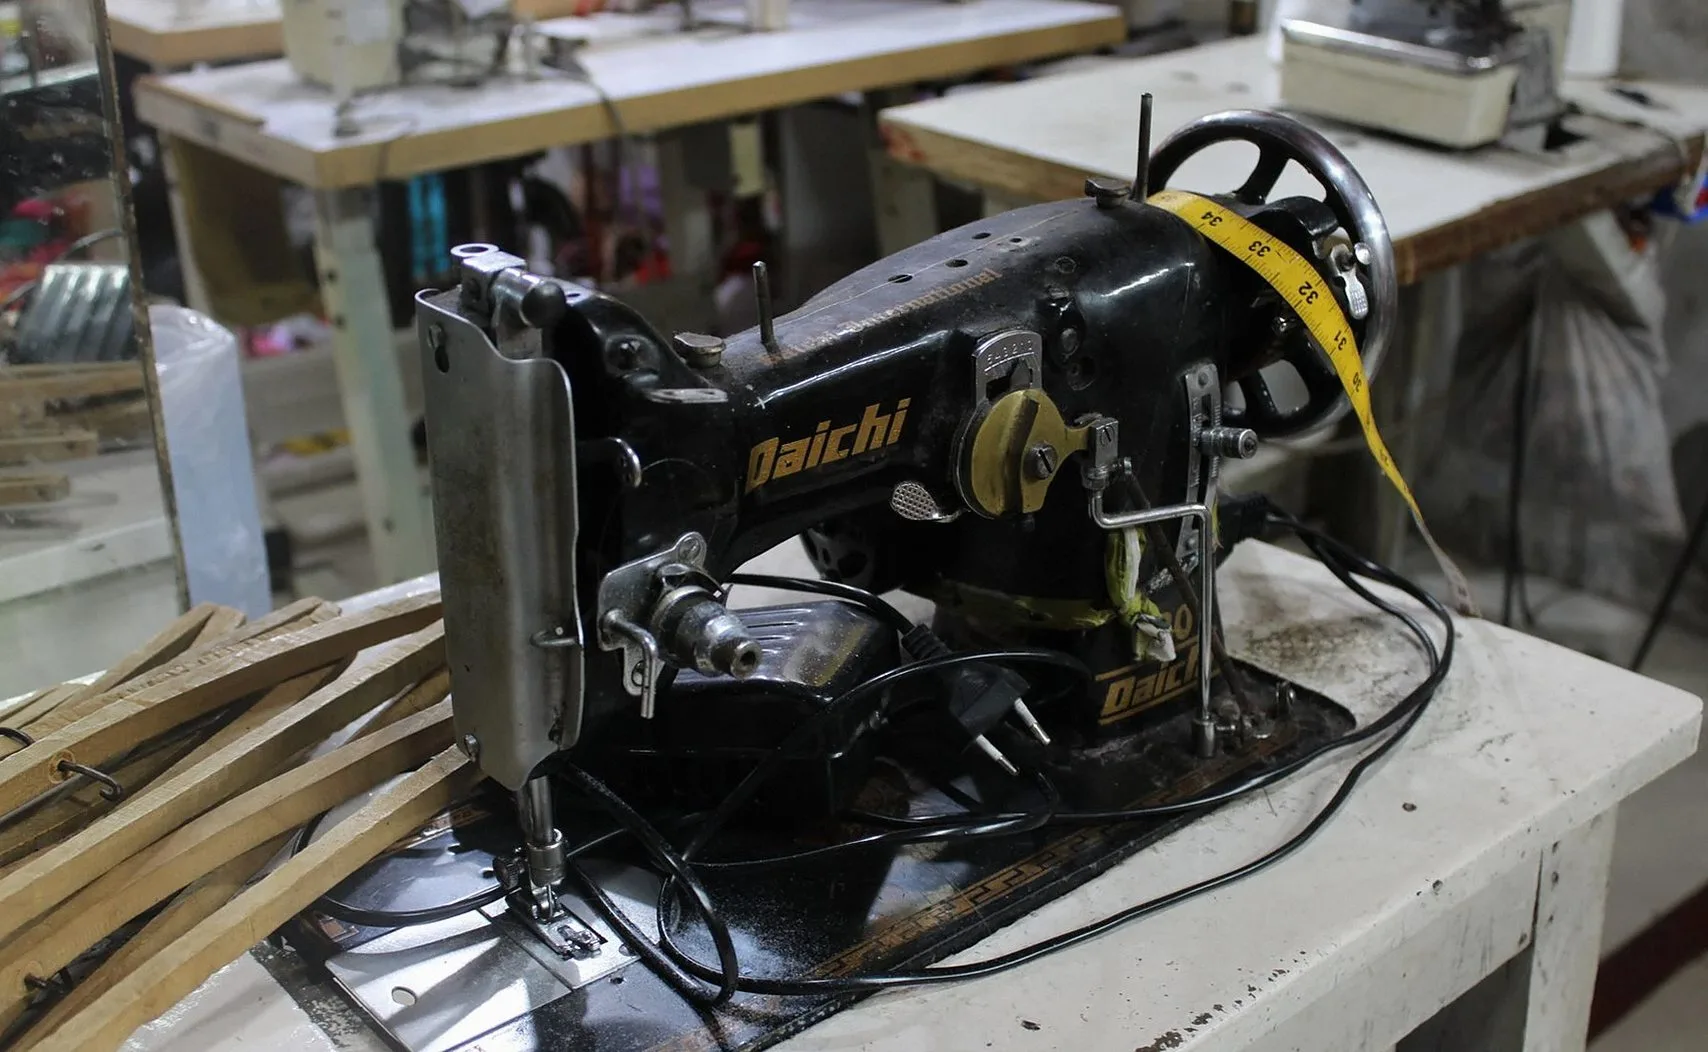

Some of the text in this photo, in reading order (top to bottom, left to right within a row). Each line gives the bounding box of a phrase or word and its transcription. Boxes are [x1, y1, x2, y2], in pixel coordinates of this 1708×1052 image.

[1200, 210, 1224, 228] 34
[1247, 240, 1272, 258] 33
[1298, 280, 1320, 305] 32
[1333, 330, 1348, 351] 31
[745, 397, 911, 495] Daichi
